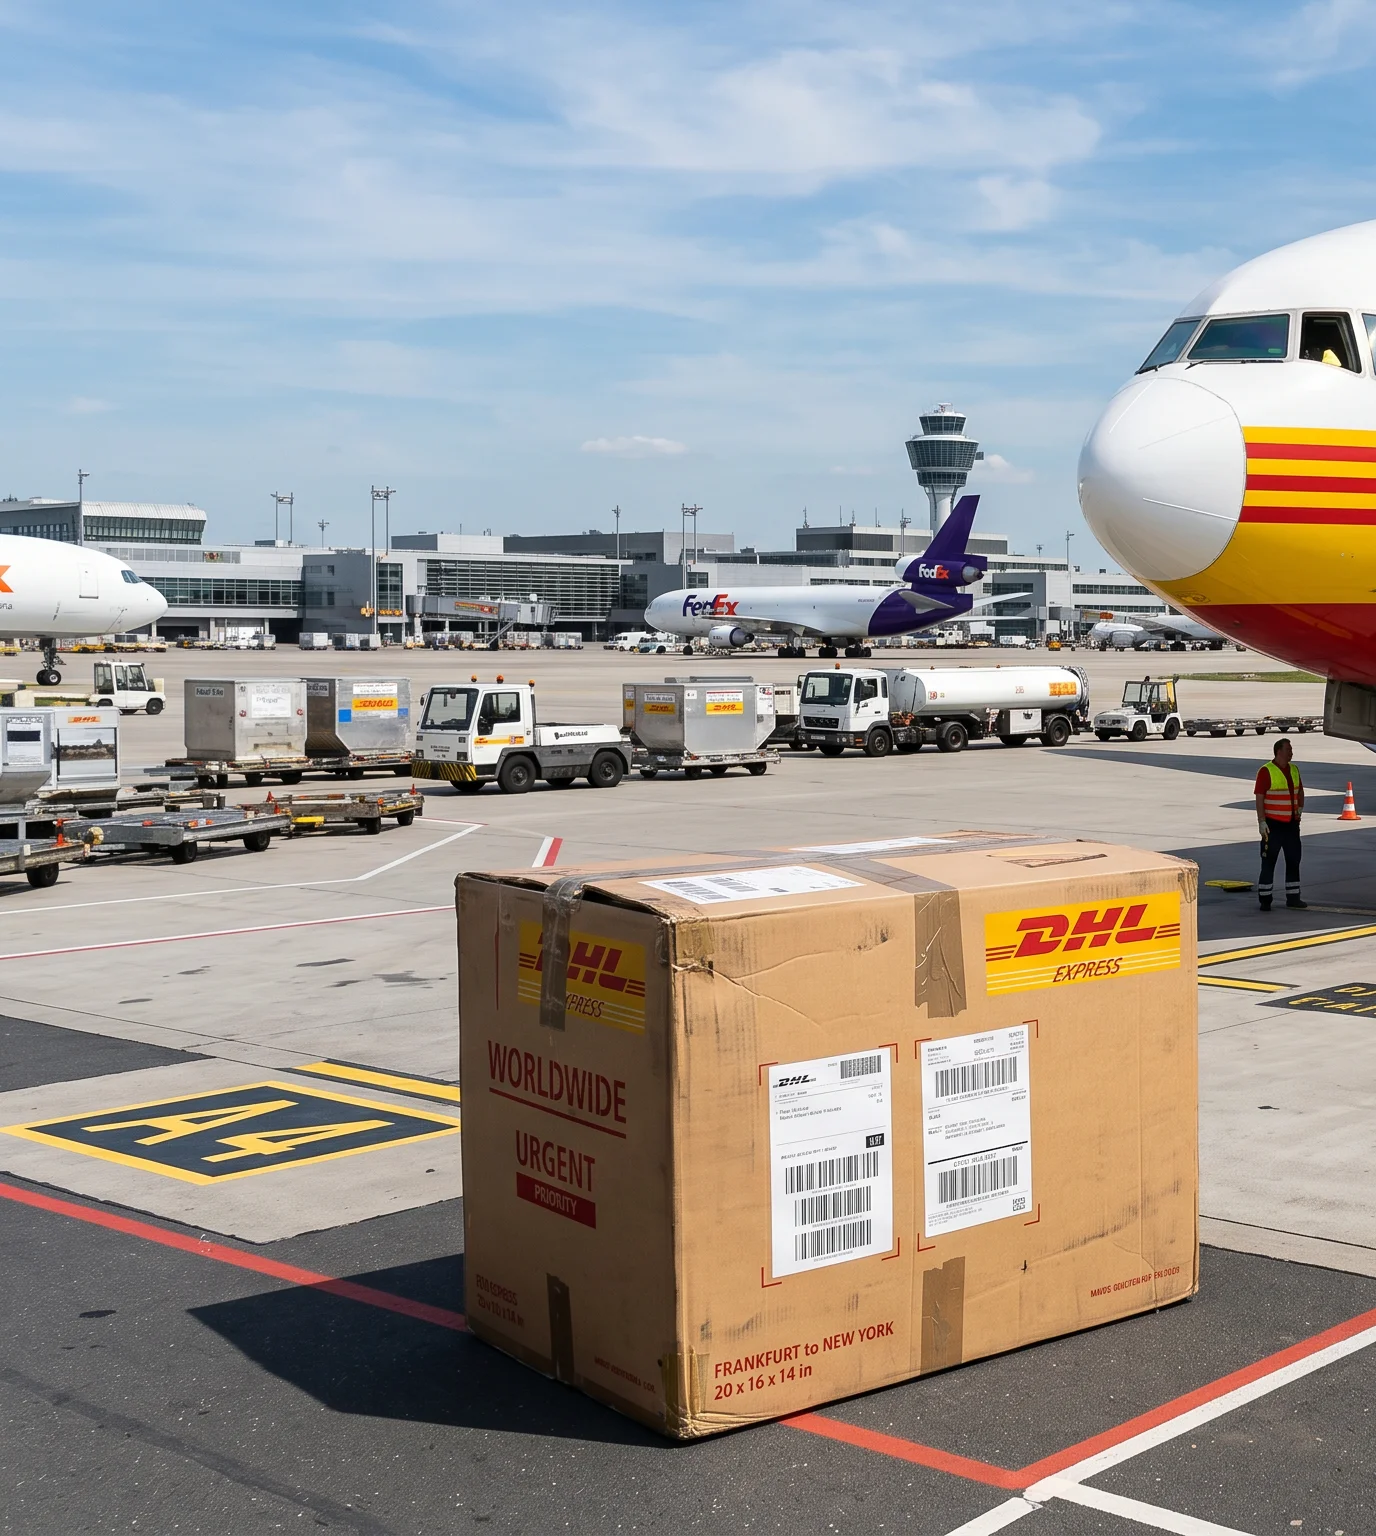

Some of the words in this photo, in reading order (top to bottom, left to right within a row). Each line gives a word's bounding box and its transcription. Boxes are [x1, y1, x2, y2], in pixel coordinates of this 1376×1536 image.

[1014, 903, 1157, 958] DHL
[1052, 957, 1123, 983] EXPRESS
[488, 1040, 627, 1124] WORLDWIDE
[778, 1074, 810, 1087] DHL
[82, 1099, 395, 1163] A4
[515, 1129, 595, 1192] URGENT
[534, 1184, 577, 1216] PRIORITY
[714, 1344, 801, 1379] FRANKFURT
[804, 1343, 819, 1357] to
[823, 1331, 855, 1352] NEW
[857, 1321, 894, 1343] YORK
[714, 1382, 733, 1400] 20
[736, 1382, 745, 1394] x
[748, 1375, 765, 1391] 16
[767, 1375, 776, 1387] x
[779, 1367, 796, 1383] 14
[799, 1363, 813, 1379] in
